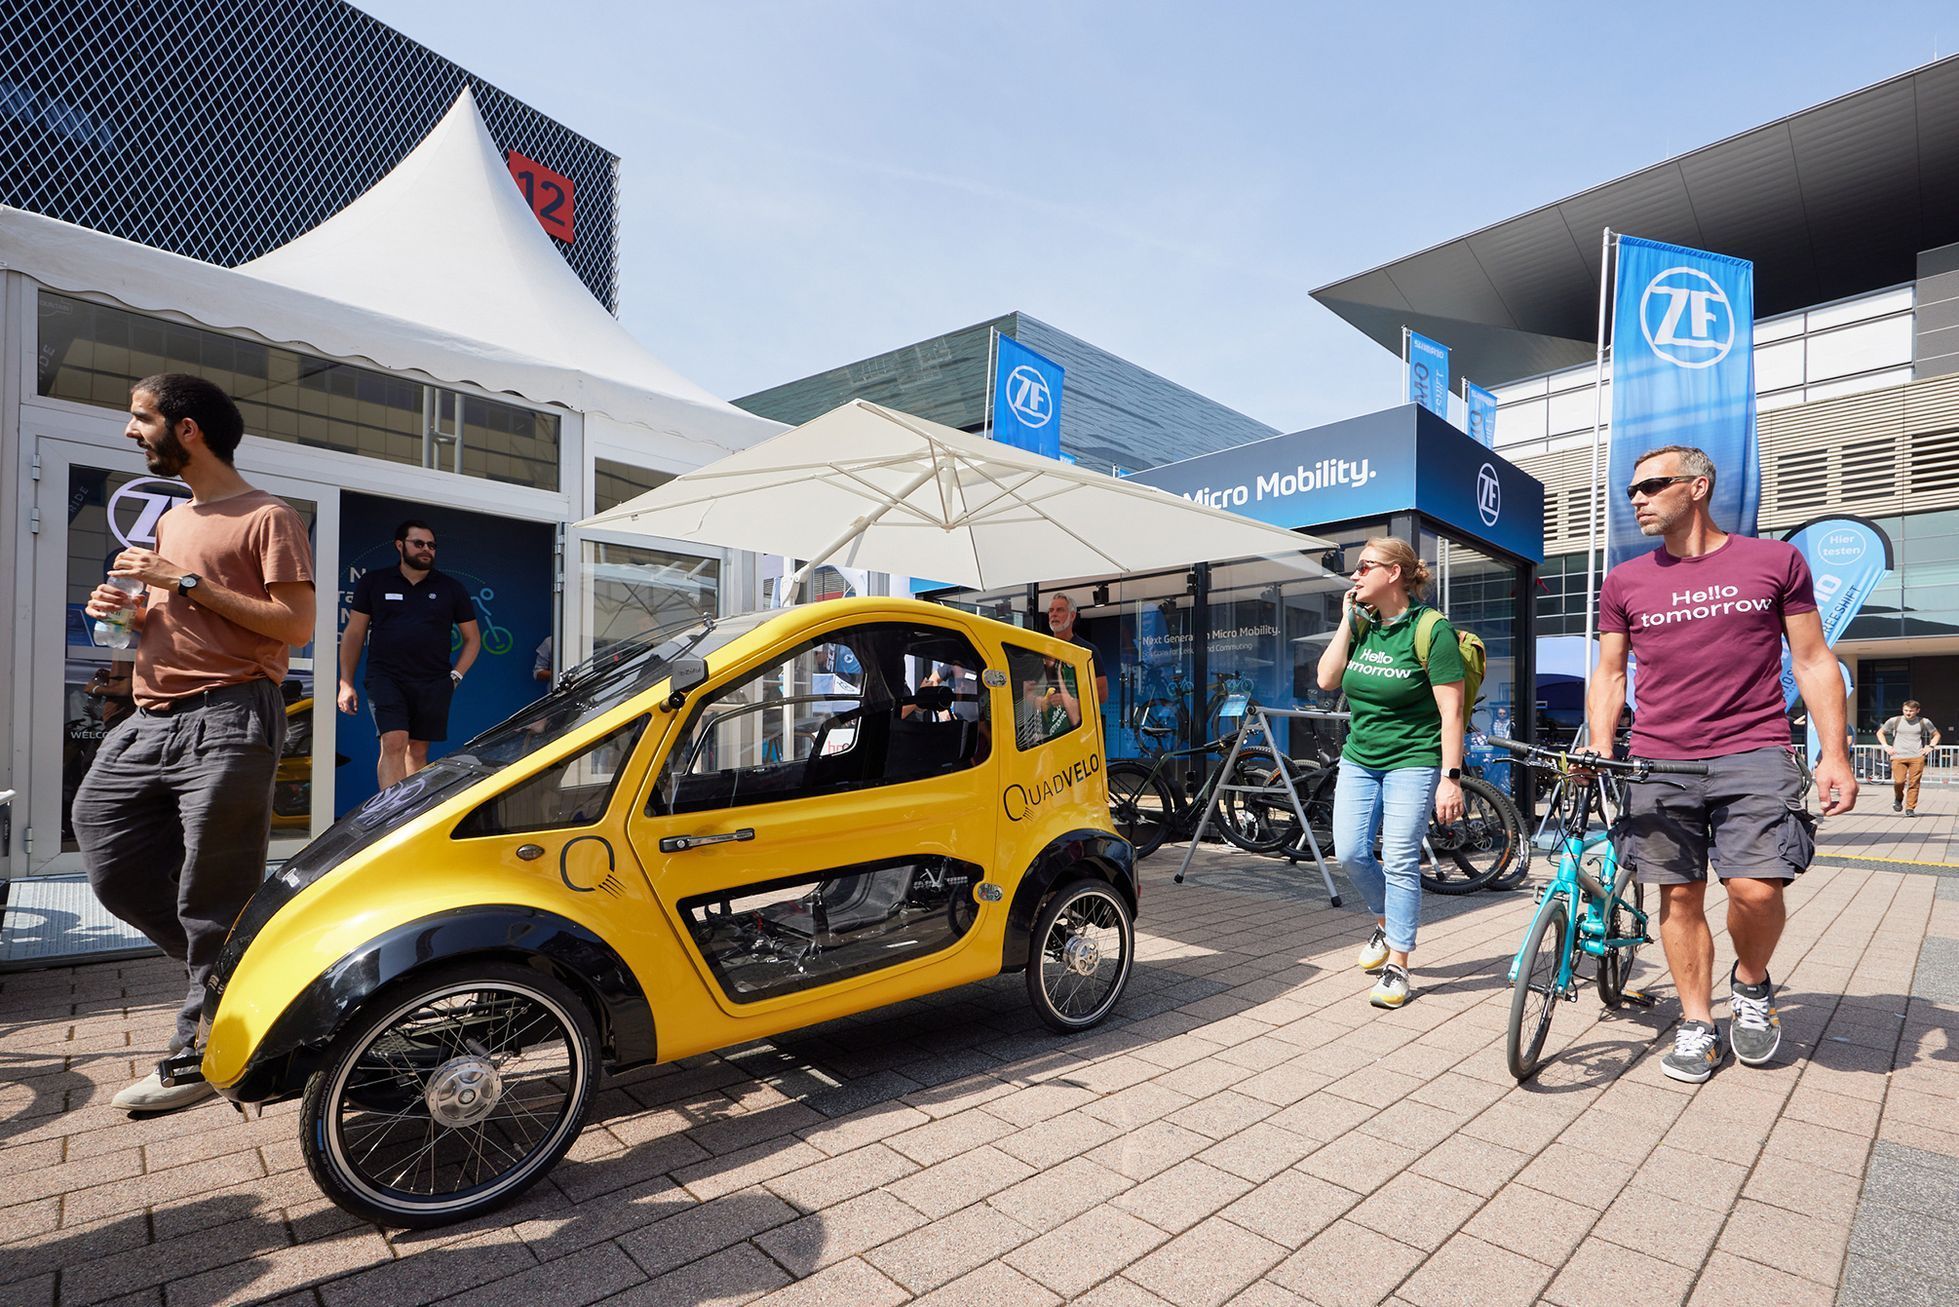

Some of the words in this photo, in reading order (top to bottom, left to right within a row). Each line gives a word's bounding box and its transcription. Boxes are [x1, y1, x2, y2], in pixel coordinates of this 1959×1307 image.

[518, 170, 565, 227] 12
[1645, 280, 1730, 354] ZF
[1012, 371, 1049, 422] ZF
[1183, 485, 1248, 510] Micro
[1256, 458, 1377, 501] Mobility.
[1479, 470, 1499, 519] ZF
[1823, 546, 1861, 557] testen
[1829, 534, 1855, 544] Hier
[1671, 585, 1739, 606] Hello
[1641, 598, 1772, 628] tomorrow
[1142, 635, 1162, 646] Next
[1212, 629, 1237, 639] Micro
[1239, 624, 1281, 637] Mobility.
[1347, 660, 1412, 678] morrow
[1360, 648, 1393, 664] Hello
